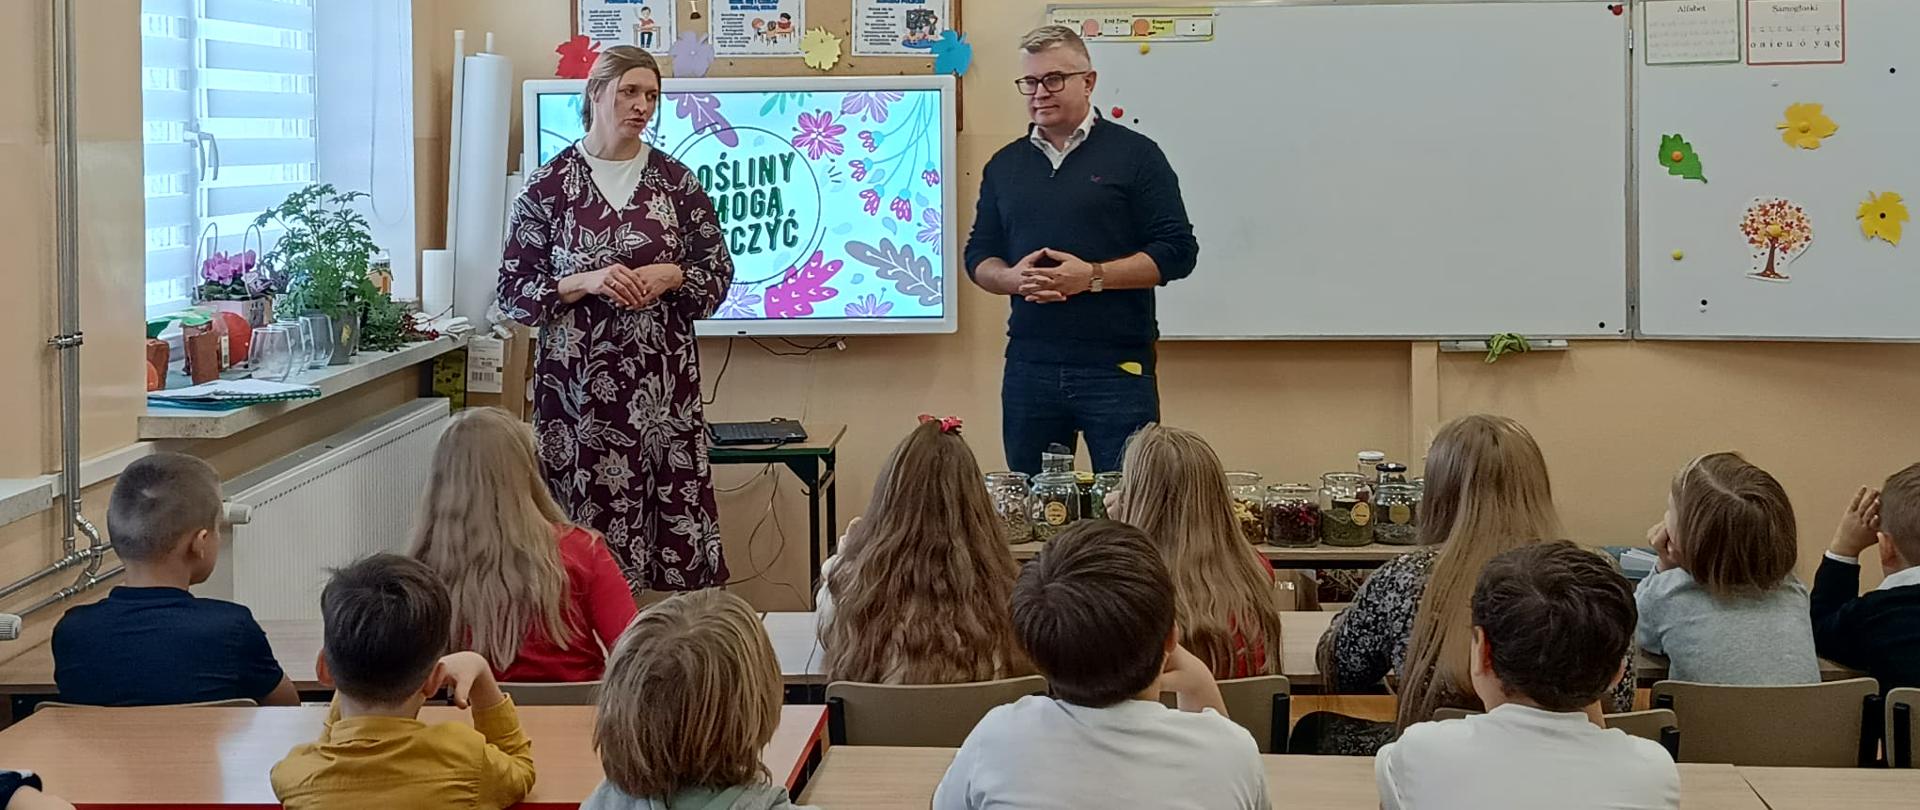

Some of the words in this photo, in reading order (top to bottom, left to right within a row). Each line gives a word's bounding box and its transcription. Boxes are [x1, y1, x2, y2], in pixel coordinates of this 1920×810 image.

[1677, 4, 1706, 13] Alfabet
[697, 152, 796, 194] OŚLINY
[722, 209, 799, 256] CZYĆ
